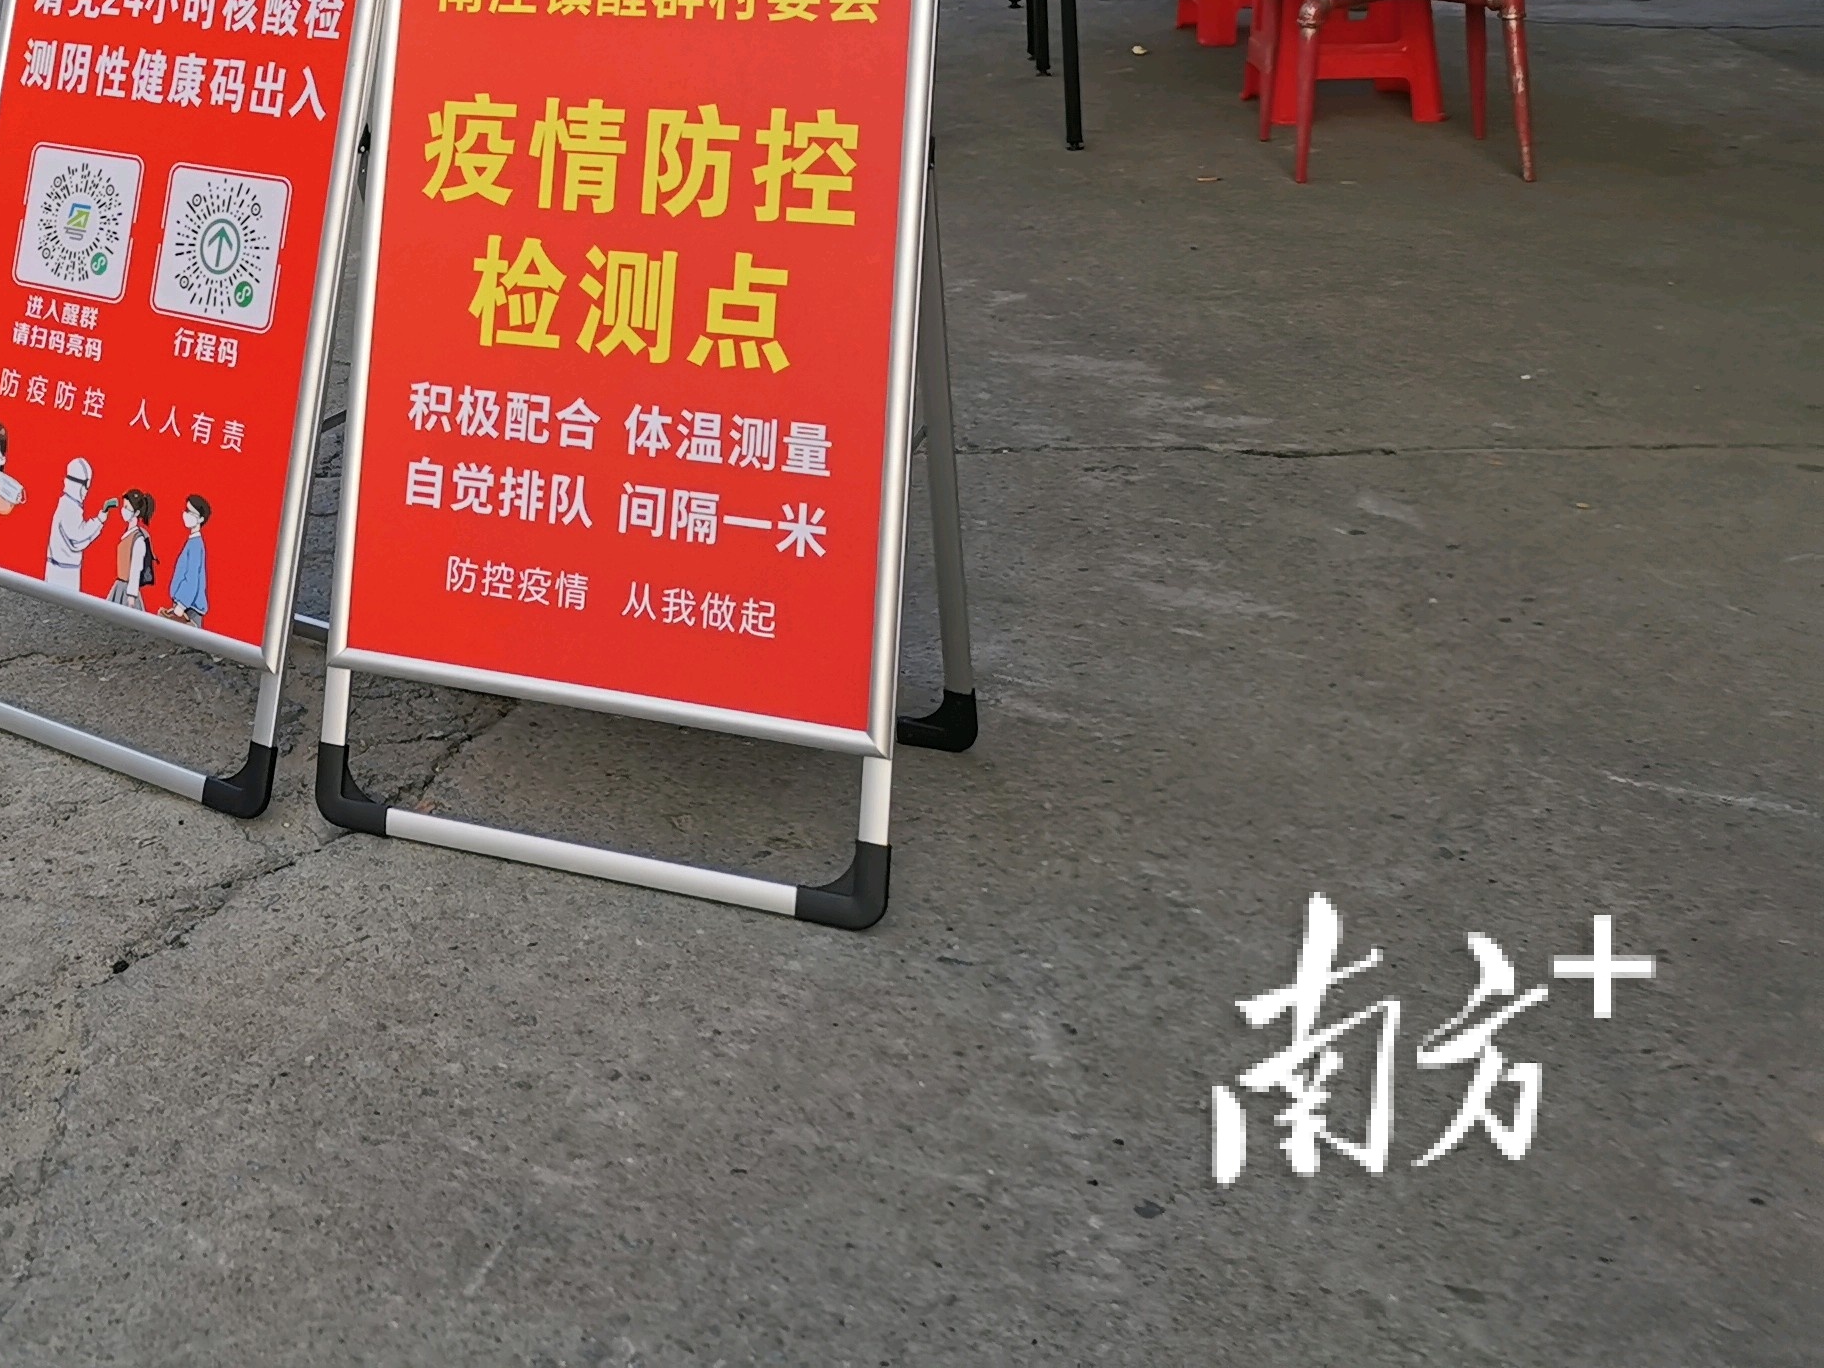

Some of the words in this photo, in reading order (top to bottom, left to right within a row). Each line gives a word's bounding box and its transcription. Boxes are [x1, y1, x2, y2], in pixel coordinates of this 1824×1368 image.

[21, 39, 325, 120] 测阴性健康码出入
[422, 93, 858, 225] 疫情防控
[13, 322, 102, 361] 请扫码亮码
[26, 295, 98, 329] 进入醒群
[469, 235, 789, 373] 检测点
[174, 328, 237, 367] 行程码
[0, 369, 105, 418] 防疫防控
[130, 400, 244, 452] 人人有责
[408, 382, 600, 449] 积极配合
[625, 404, 832, 476] 体温测量
[406, 457, 592, 528] 自觉排队
[619, 482, 826, 557] 间隔一米
[446, 556, 588, 610] 防控疫情
[622, 582, 775, 638] 从我做起
